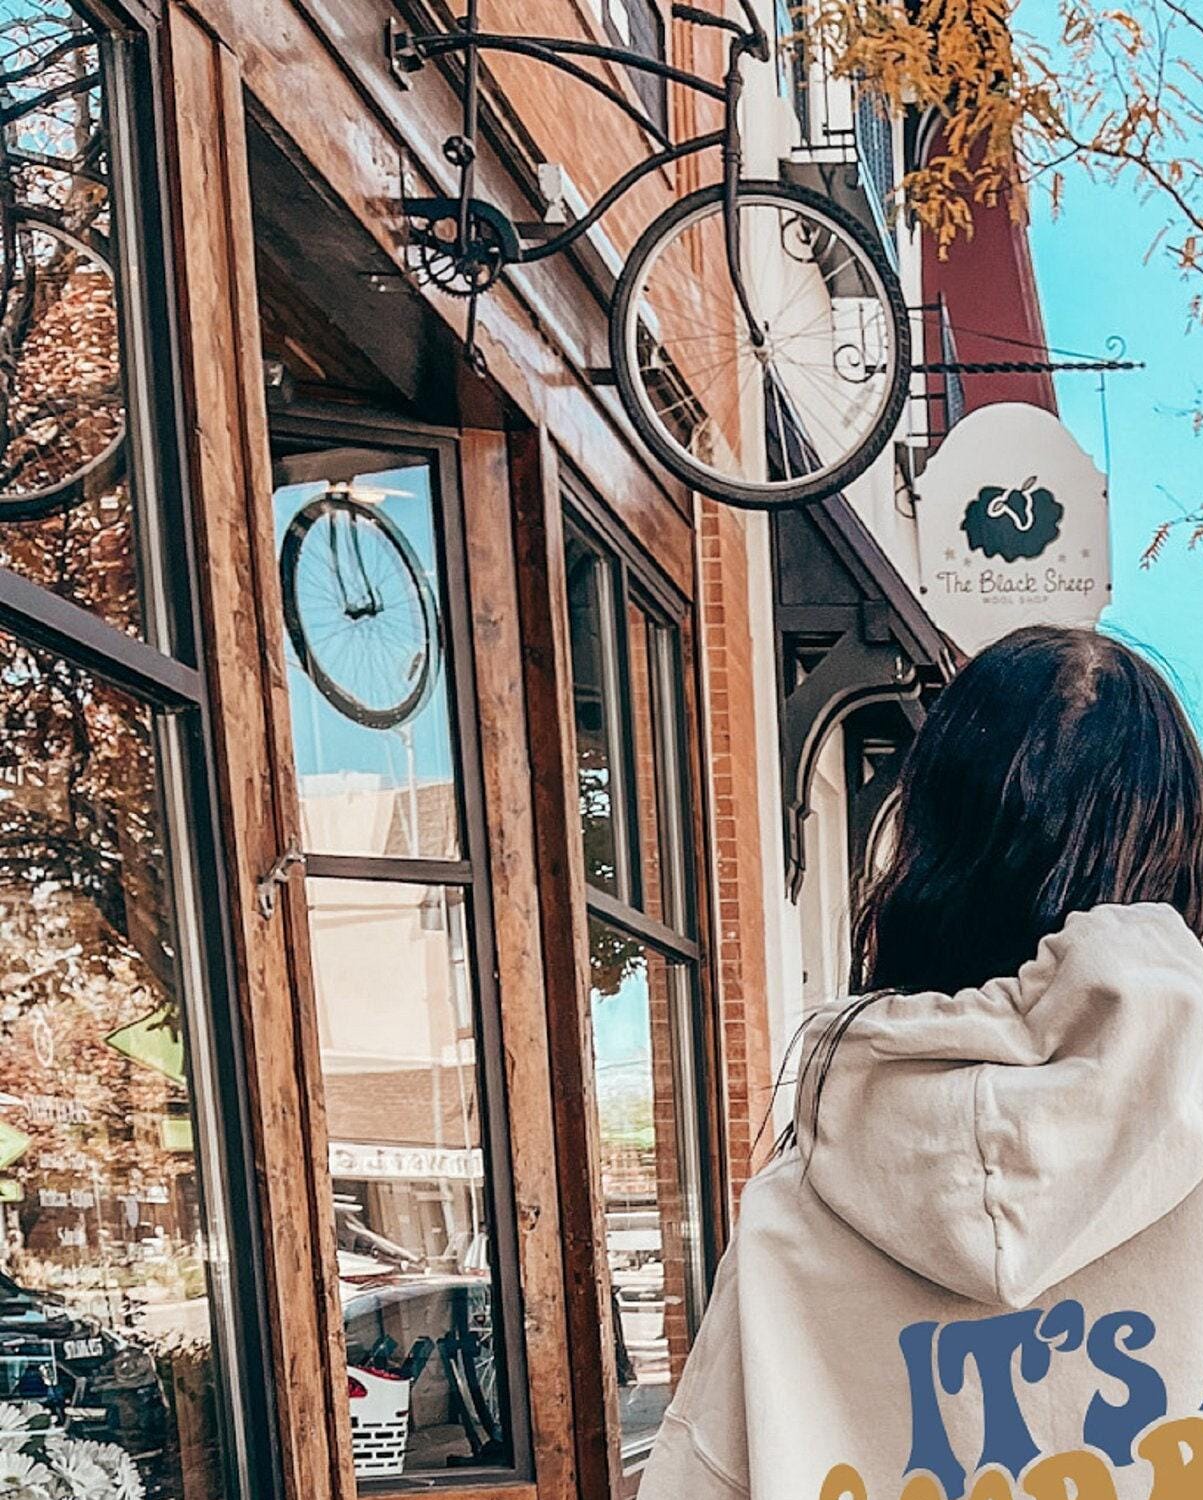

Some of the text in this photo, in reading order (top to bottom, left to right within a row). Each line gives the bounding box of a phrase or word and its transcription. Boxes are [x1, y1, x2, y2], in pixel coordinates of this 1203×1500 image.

[936, 567, 1095, 596] The Black Sheep
[900, 1300, 1168, 1500] IT'S
